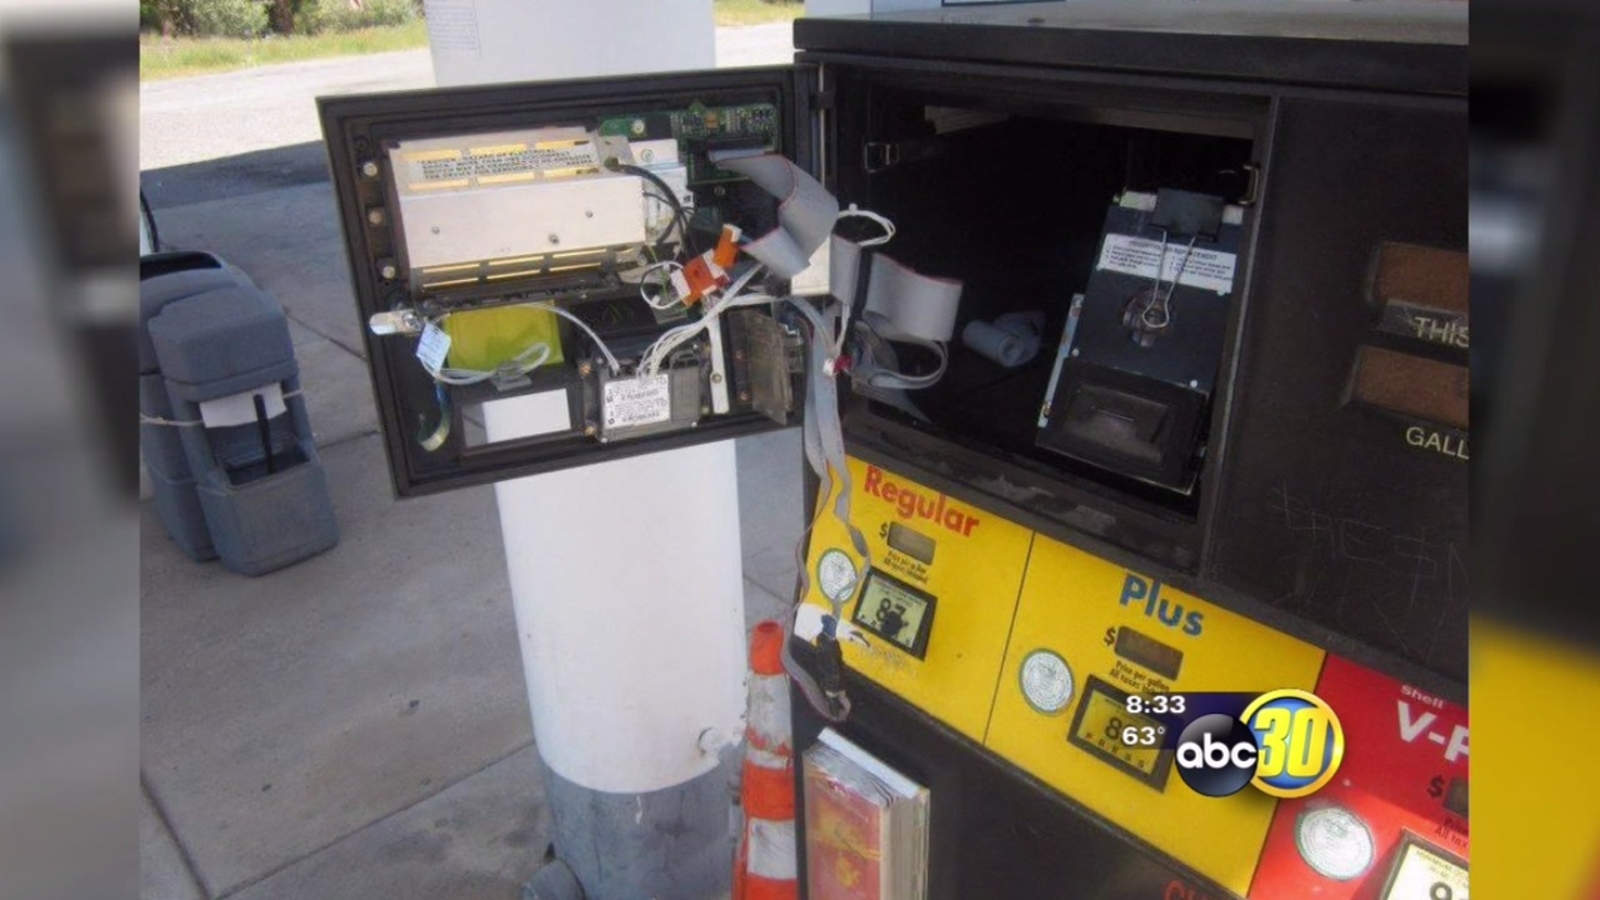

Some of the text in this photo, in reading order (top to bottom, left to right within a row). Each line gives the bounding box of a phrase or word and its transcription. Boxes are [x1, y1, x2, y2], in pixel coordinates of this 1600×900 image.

[1414, 316, 1469, 348] THIS
[1405, 426, 1469, 460] GALL
[864, 464, 980, 537] Regular
[879, 522, 888, 540] $
[1119, 573, 1205, 636] Plus
[1104, 627, 1116, 646] $
[1116, 660, 1132, 673] Price
[1401, 684, 1443, 710] Shell
[1427, 775, 1444, 798] $
[1434, 826, 1448, 840] All
